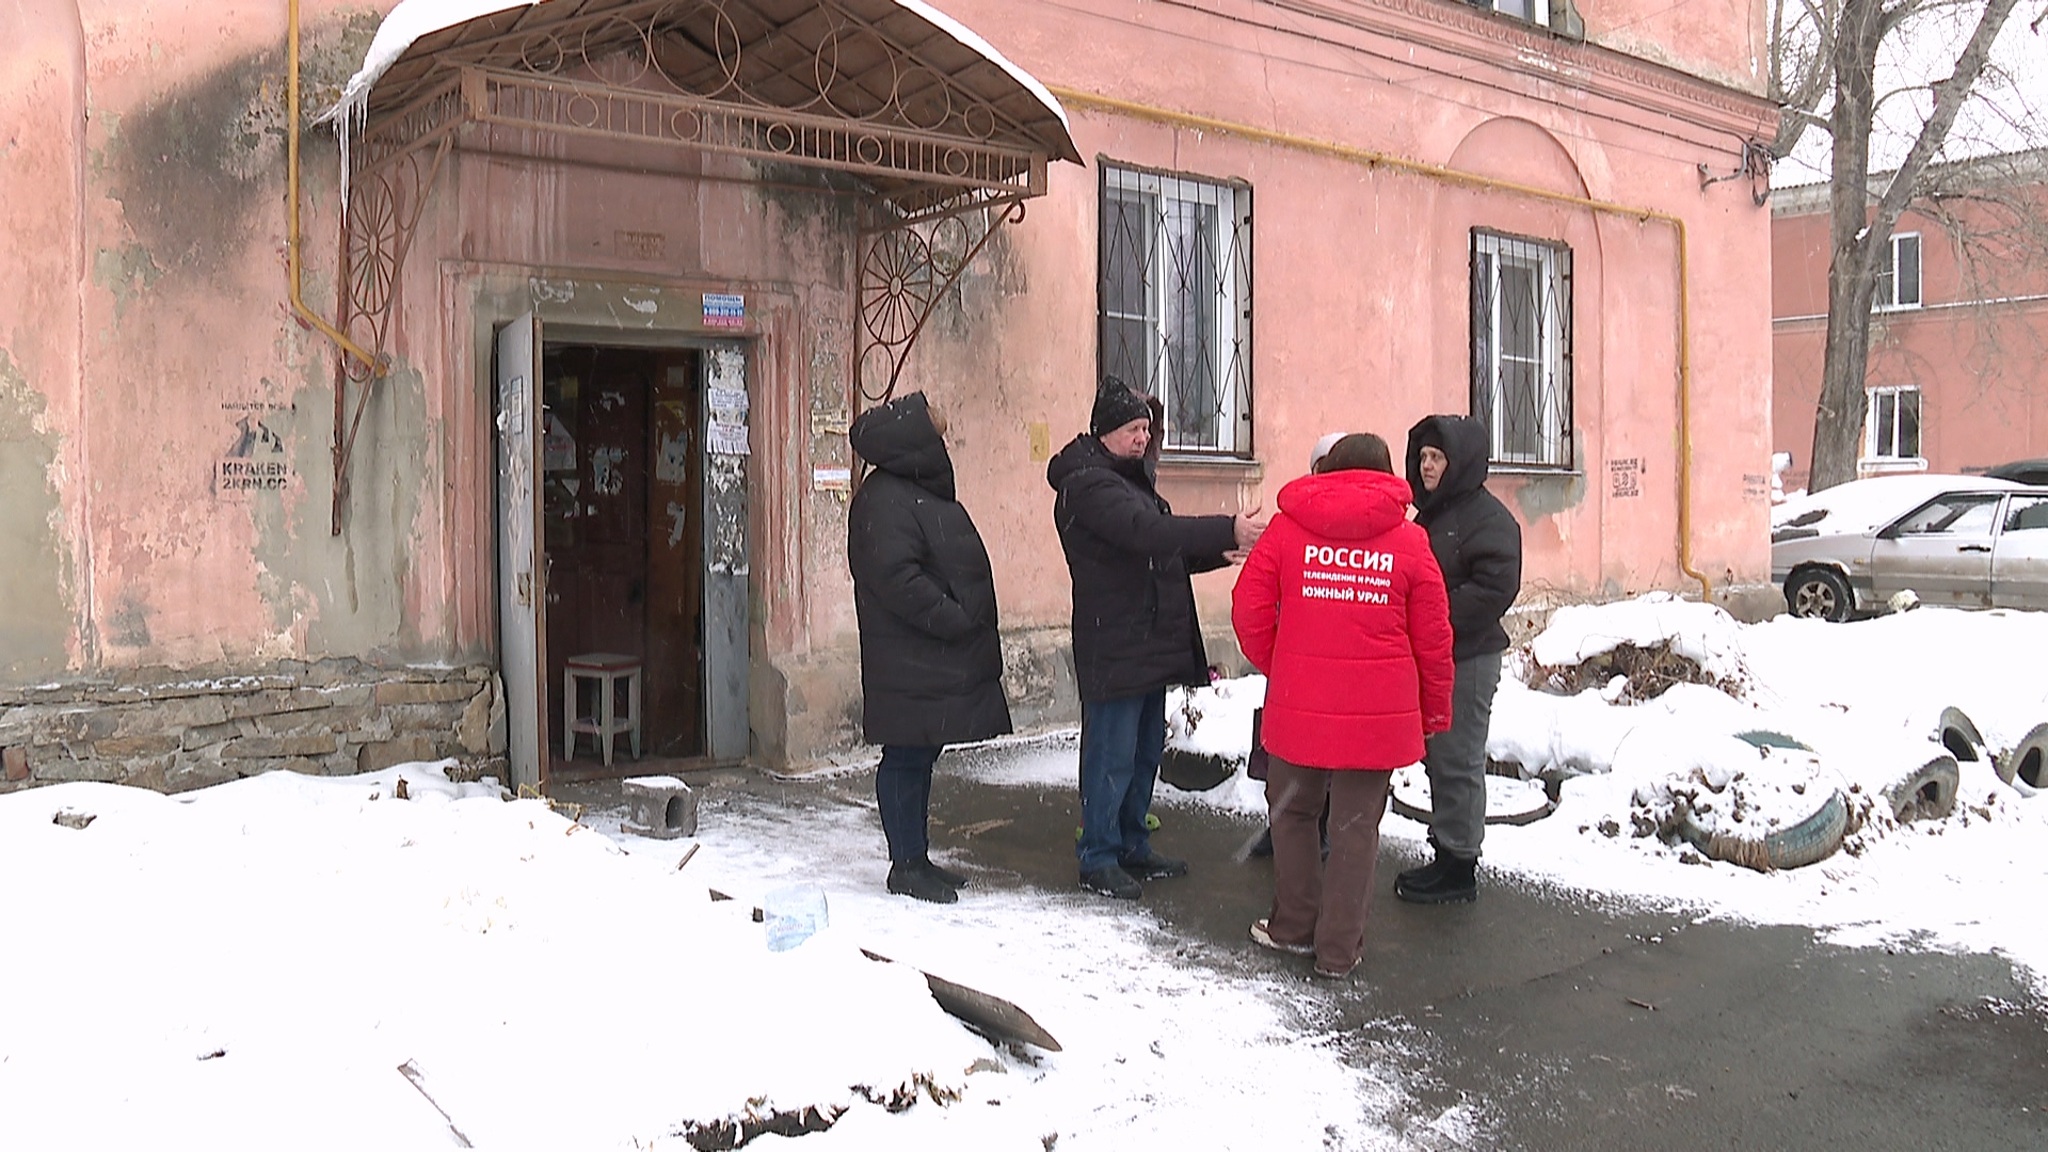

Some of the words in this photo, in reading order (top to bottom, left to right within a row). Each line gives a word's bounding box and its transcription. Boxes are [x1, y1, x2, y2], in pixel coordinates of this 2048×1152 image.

[222, 462, 287, 476] KRAKEN
[1304, 545, 1393, 573] РОССИЯ
[1303, 571, 1356, 582] ТЕЛЕВИДЕНИЕ
[1365, 577, 1391, 587] РАДИО
[1302, 585, 1354, 601] ЮЖНЫЙ
[1357, 590, 1388, 605] УРАЛ
